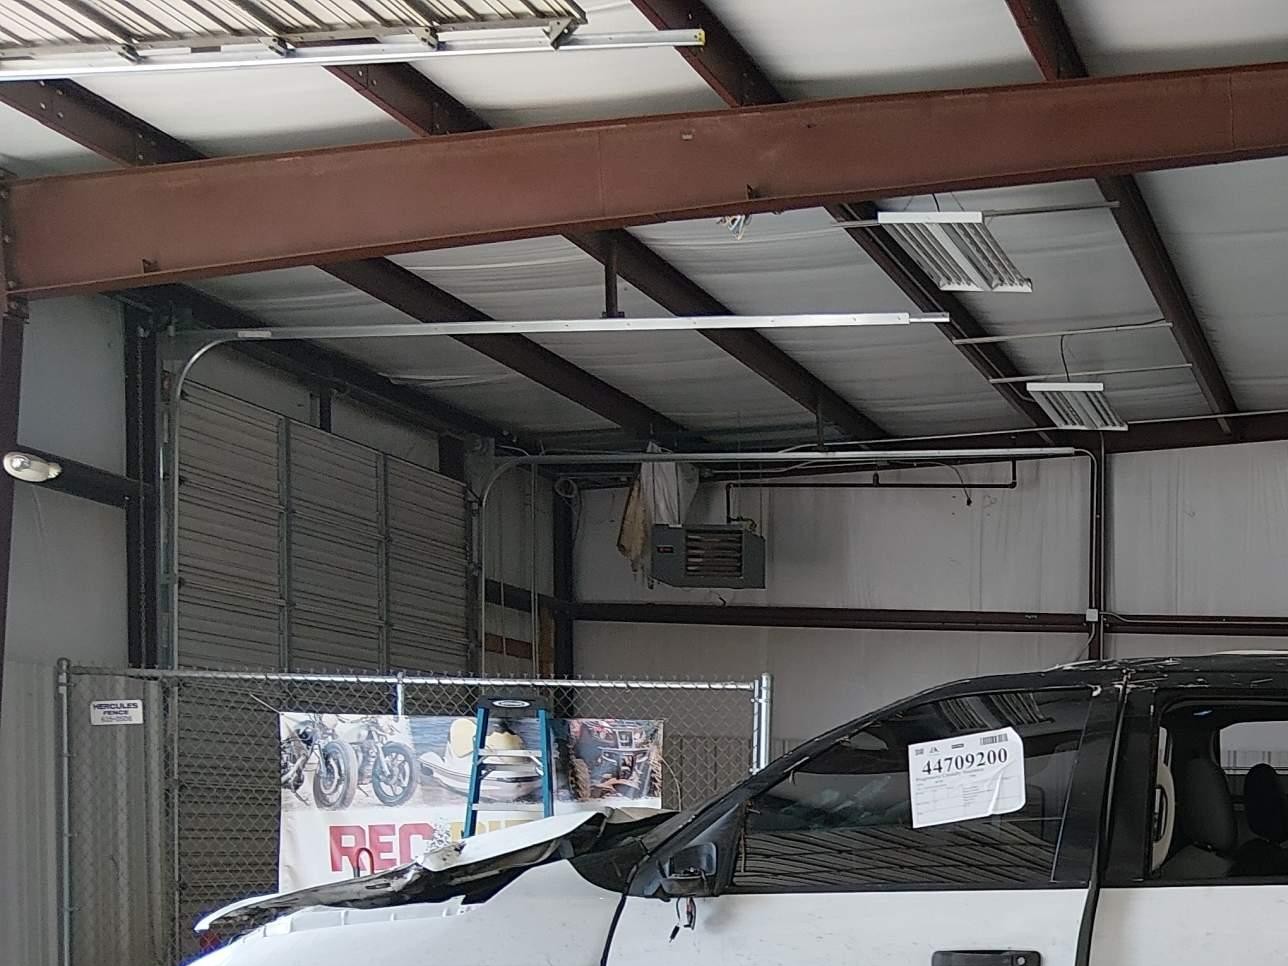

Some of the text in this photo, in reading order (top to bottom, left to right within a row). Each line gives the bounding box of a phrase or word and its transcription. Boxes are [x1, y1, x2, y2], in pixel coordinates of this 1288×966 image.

[93, 702, 138, 710] HERCULES
[921, 747, 1008, 776] 44709200
[329, 823, 435, 873] REC
